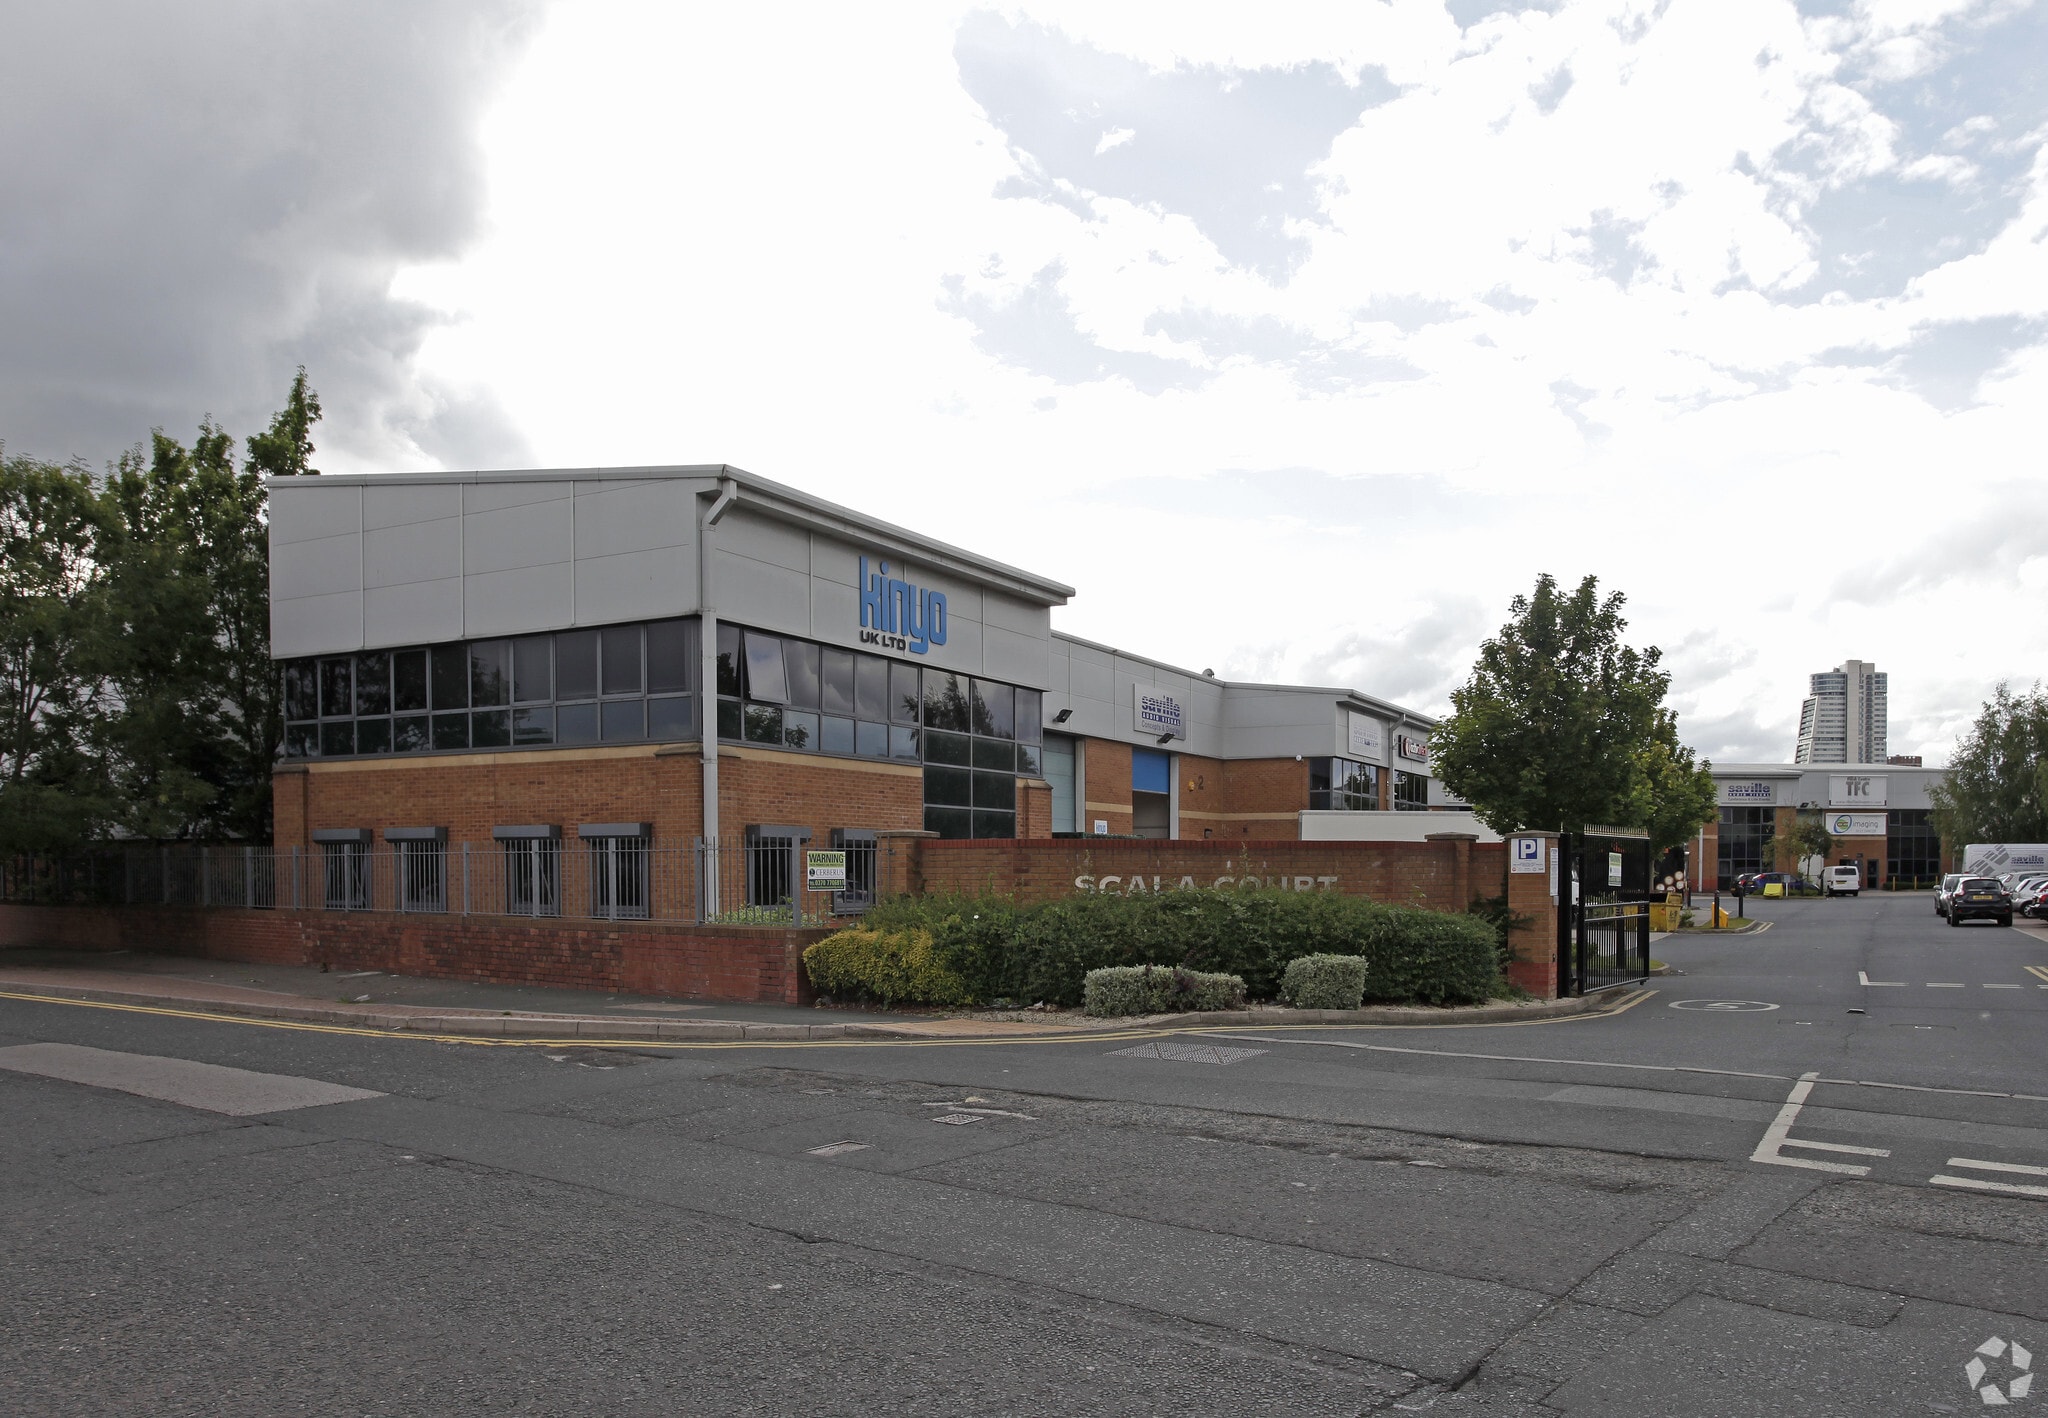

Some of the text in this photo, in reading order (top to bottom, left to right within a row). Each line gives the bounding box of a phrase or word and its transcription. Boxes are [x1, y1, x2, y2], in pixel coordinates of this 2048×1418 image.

[860, 555, 947, 655] kinyo
[860, 630, 906, 651] UK LTD
[1142, 695, 1180, 718] saville
[1142, 712, 1180, 726] AUDIO VISUAL
[1198, 774, 1204, 791] 2
[1728, 782, 1771, 793] saville
[1846, 781, 1870, 796] TFC
[1520, 840, 1536, 859] P
[809, 853, 844, 863] WARNING
[816, 869, 844, 877] CERBERUS
